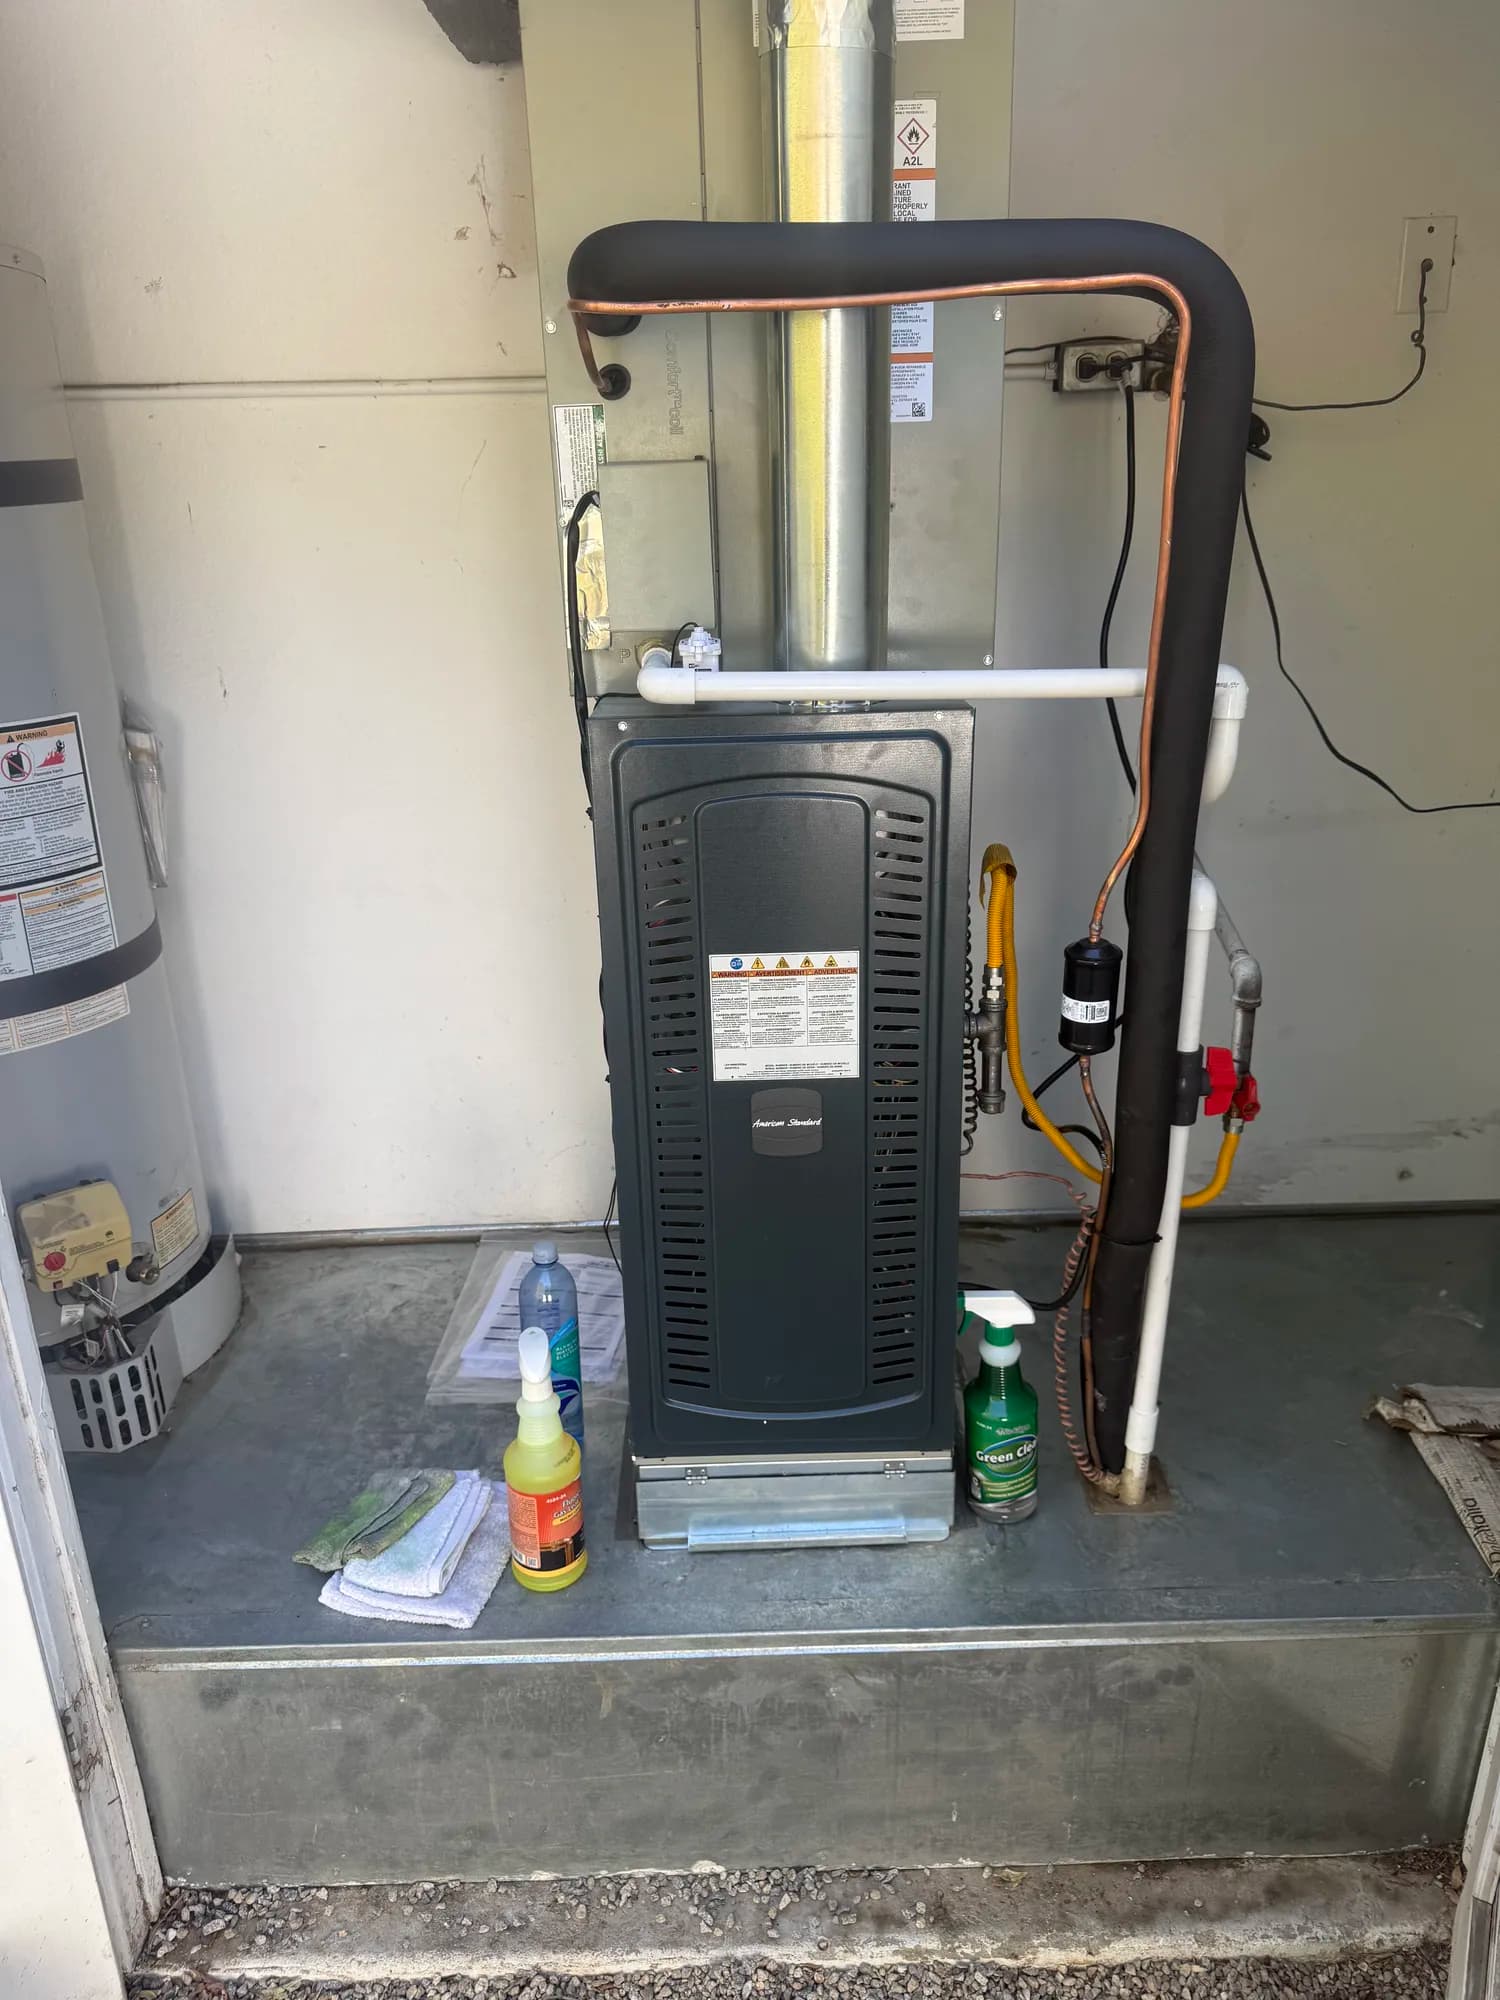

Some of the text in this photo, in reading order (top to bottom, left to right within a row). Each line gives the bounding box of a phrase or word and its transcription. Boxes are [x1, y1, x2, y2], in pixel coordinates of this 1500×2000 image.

[903, 156, 923, 166] A2L
[893, 202, 928, 210] PROPERLY
[15, 730, 48, 741] WARNING
[752, 1117, 823, 1128] American Standard
[976, 1450, 1013, 1464] Green
